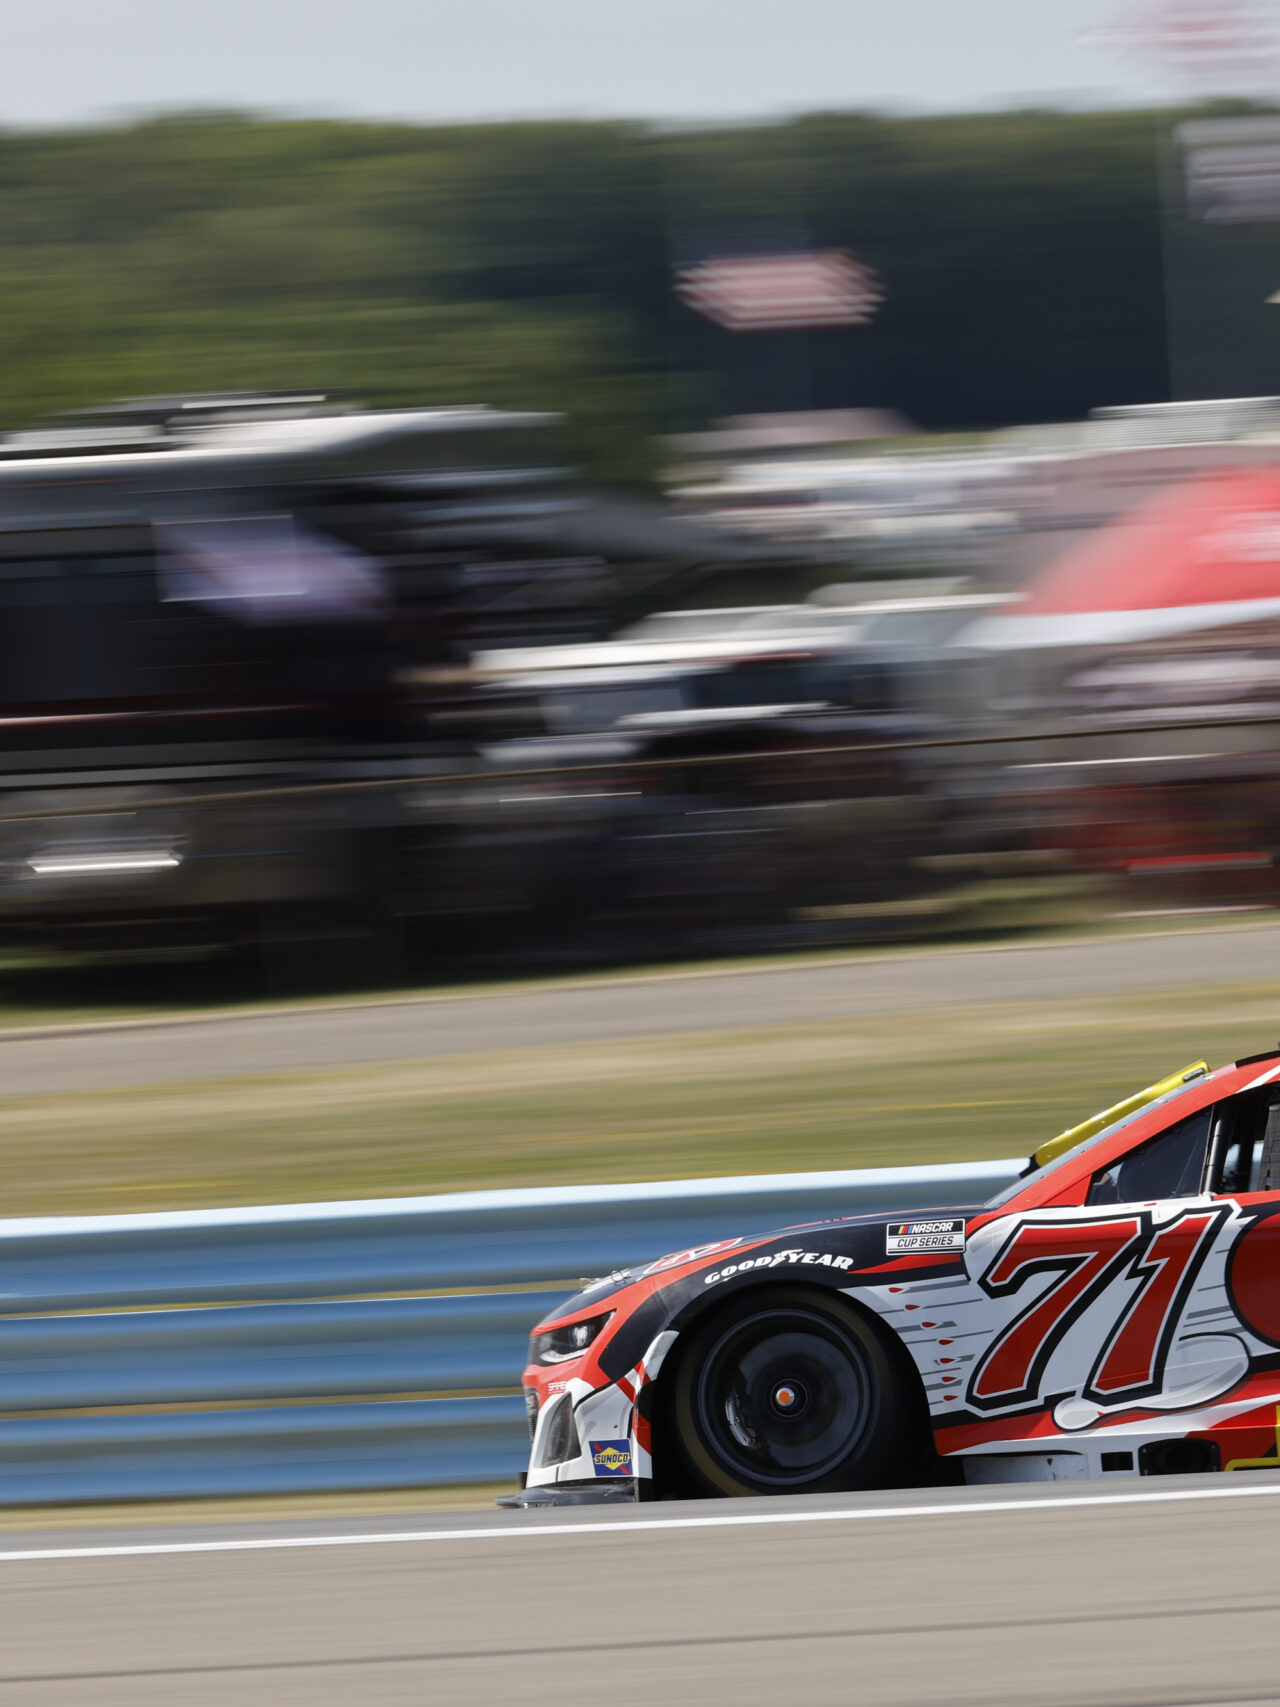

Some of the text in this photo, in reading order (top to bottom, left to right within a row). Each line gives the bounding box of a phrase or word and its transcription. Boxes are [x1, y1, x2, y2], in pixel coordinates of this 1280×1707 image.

[911, 1221, 954, 1234] NASCAR
[896, 1235, 954, 1249] CUP SERIES
[704, 1249, 854, 1285] GOODYEAR
[966, 1204, 1232, 1410] 71
[595, 1453, 629, 1464] SUNOCO
